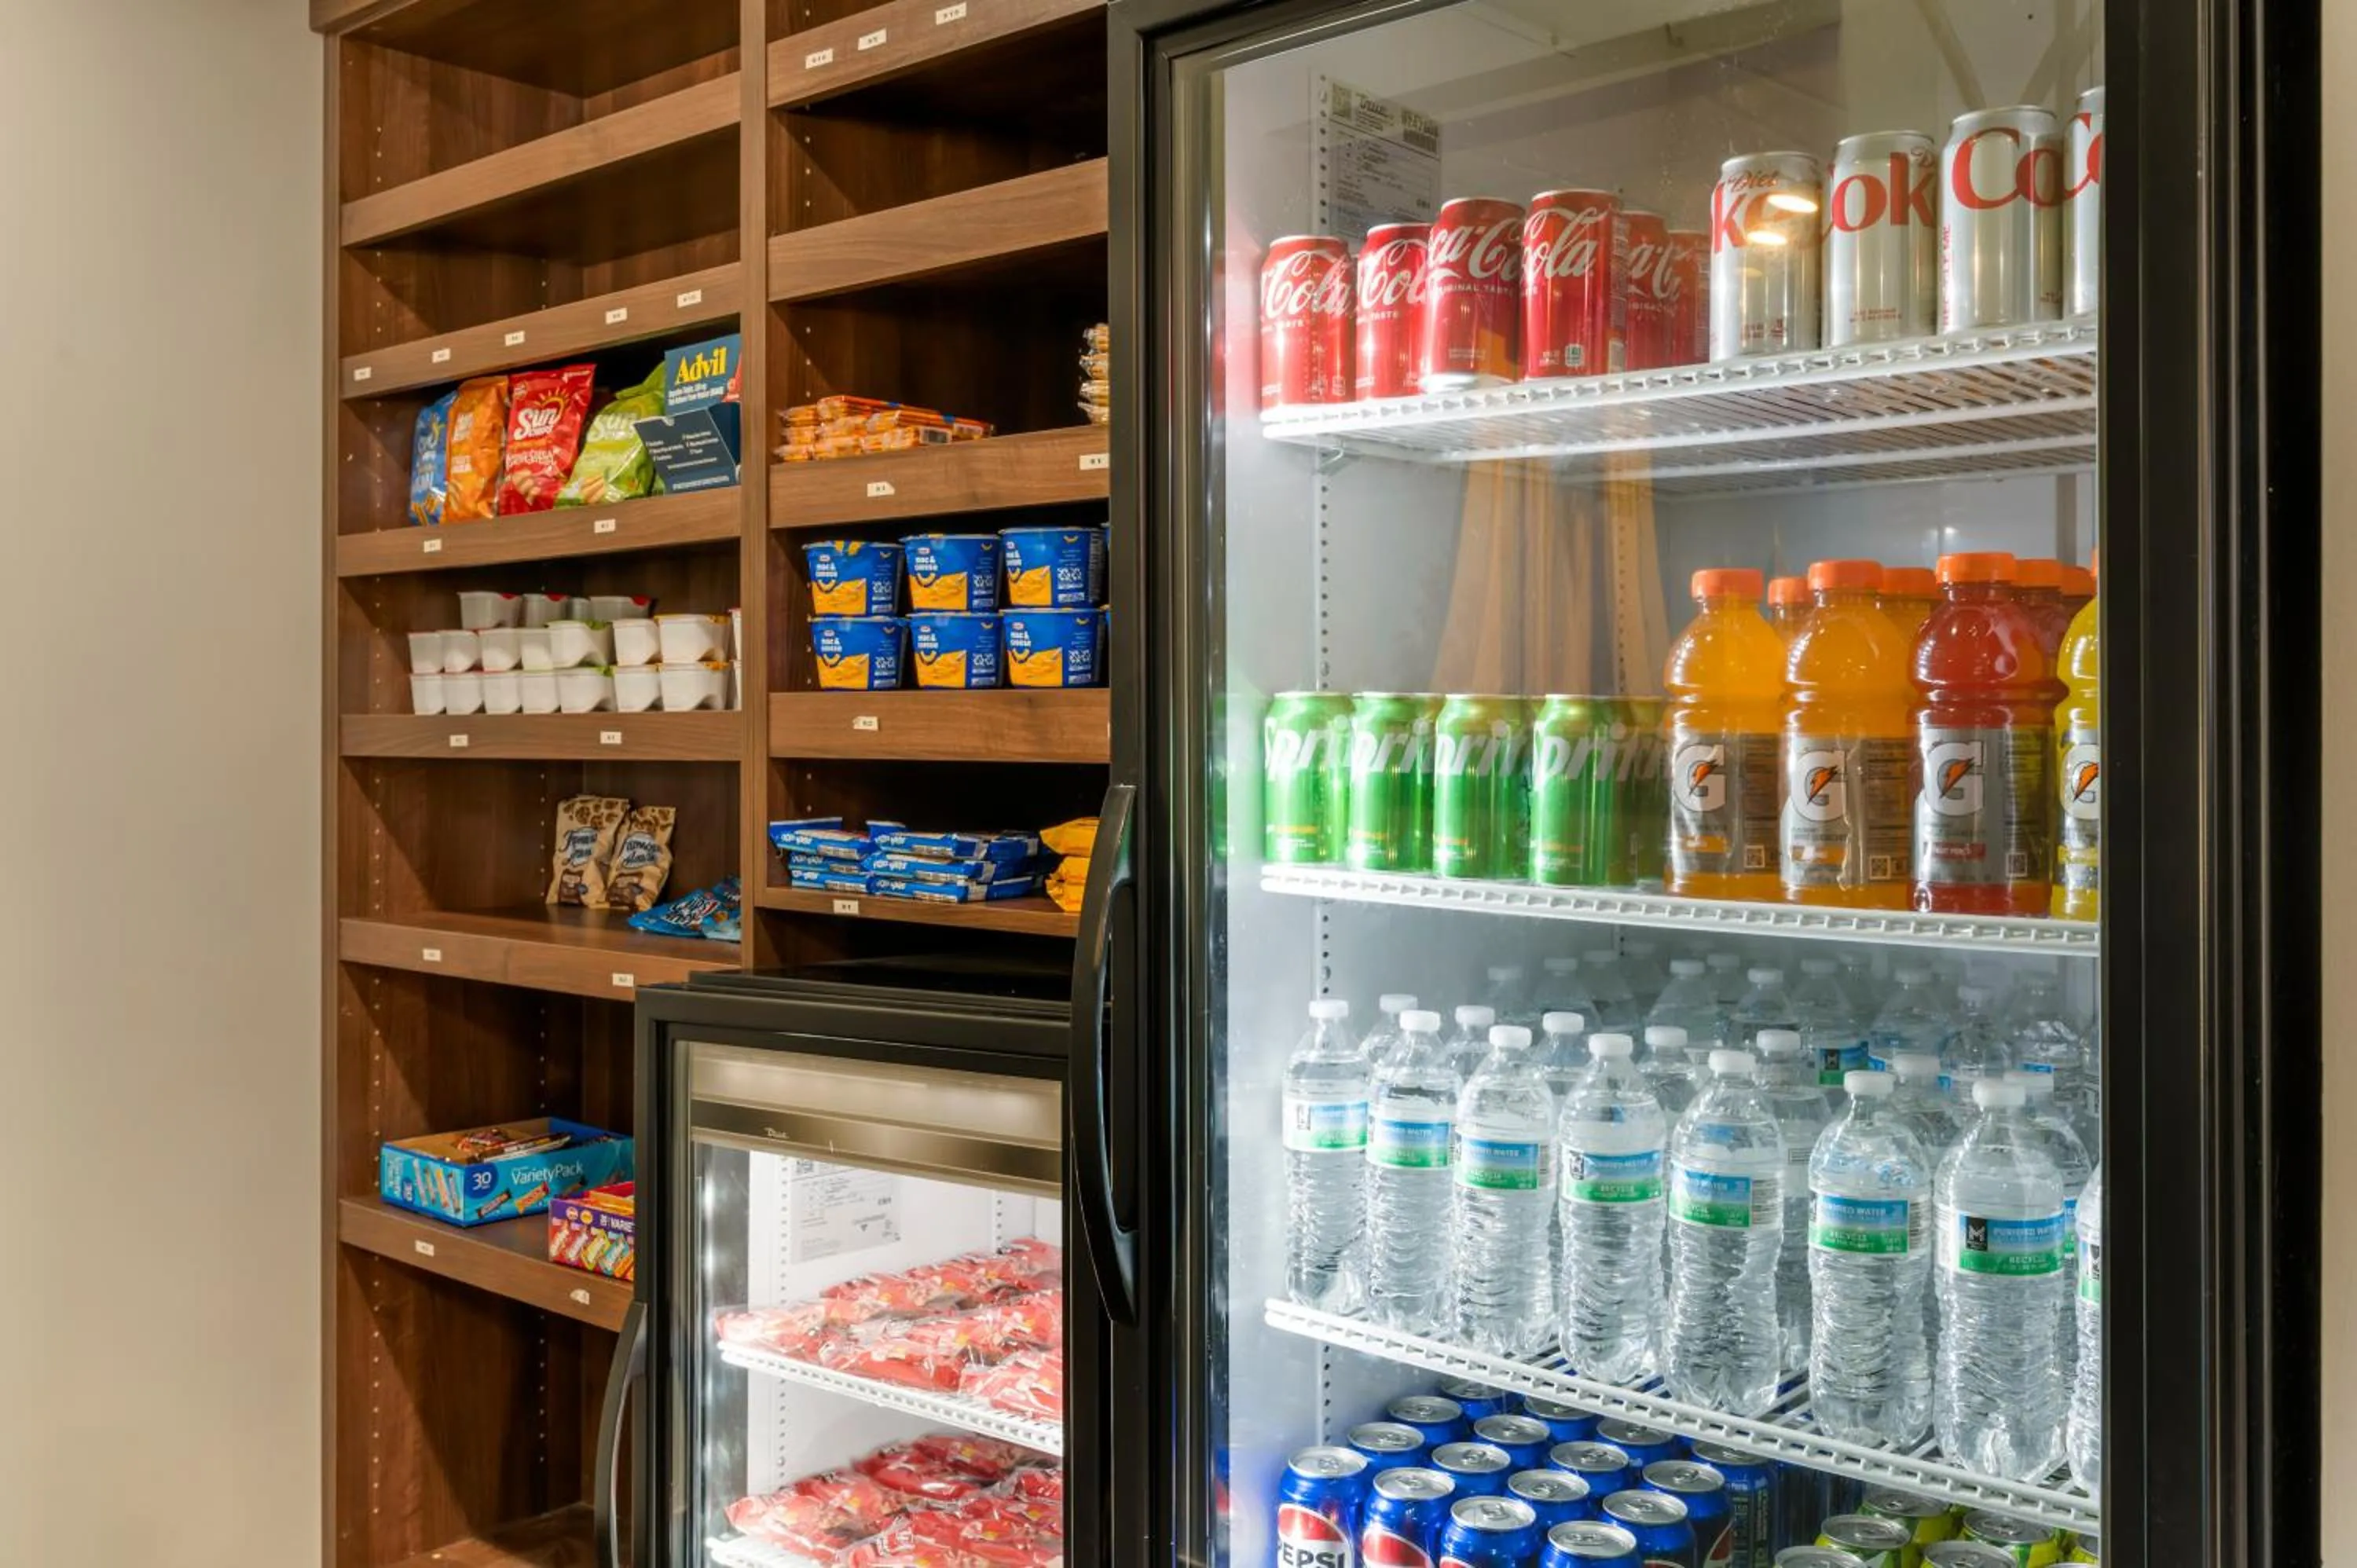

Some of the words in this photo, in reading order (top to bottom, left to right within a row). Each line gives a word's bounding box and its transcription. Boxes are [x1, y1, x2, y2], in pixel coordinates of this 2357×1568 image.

[675, 346, 727, 386] Advil
[1672, 744, 1726, 812] G
[1791, 749, 1846, 822] G
[1923, 740, 1985, 816] G
[472, 1171, 492, 1190] 30
[511, 1166, 555, 1185] Variety
[555, 1160, 585, 1178] Pack
